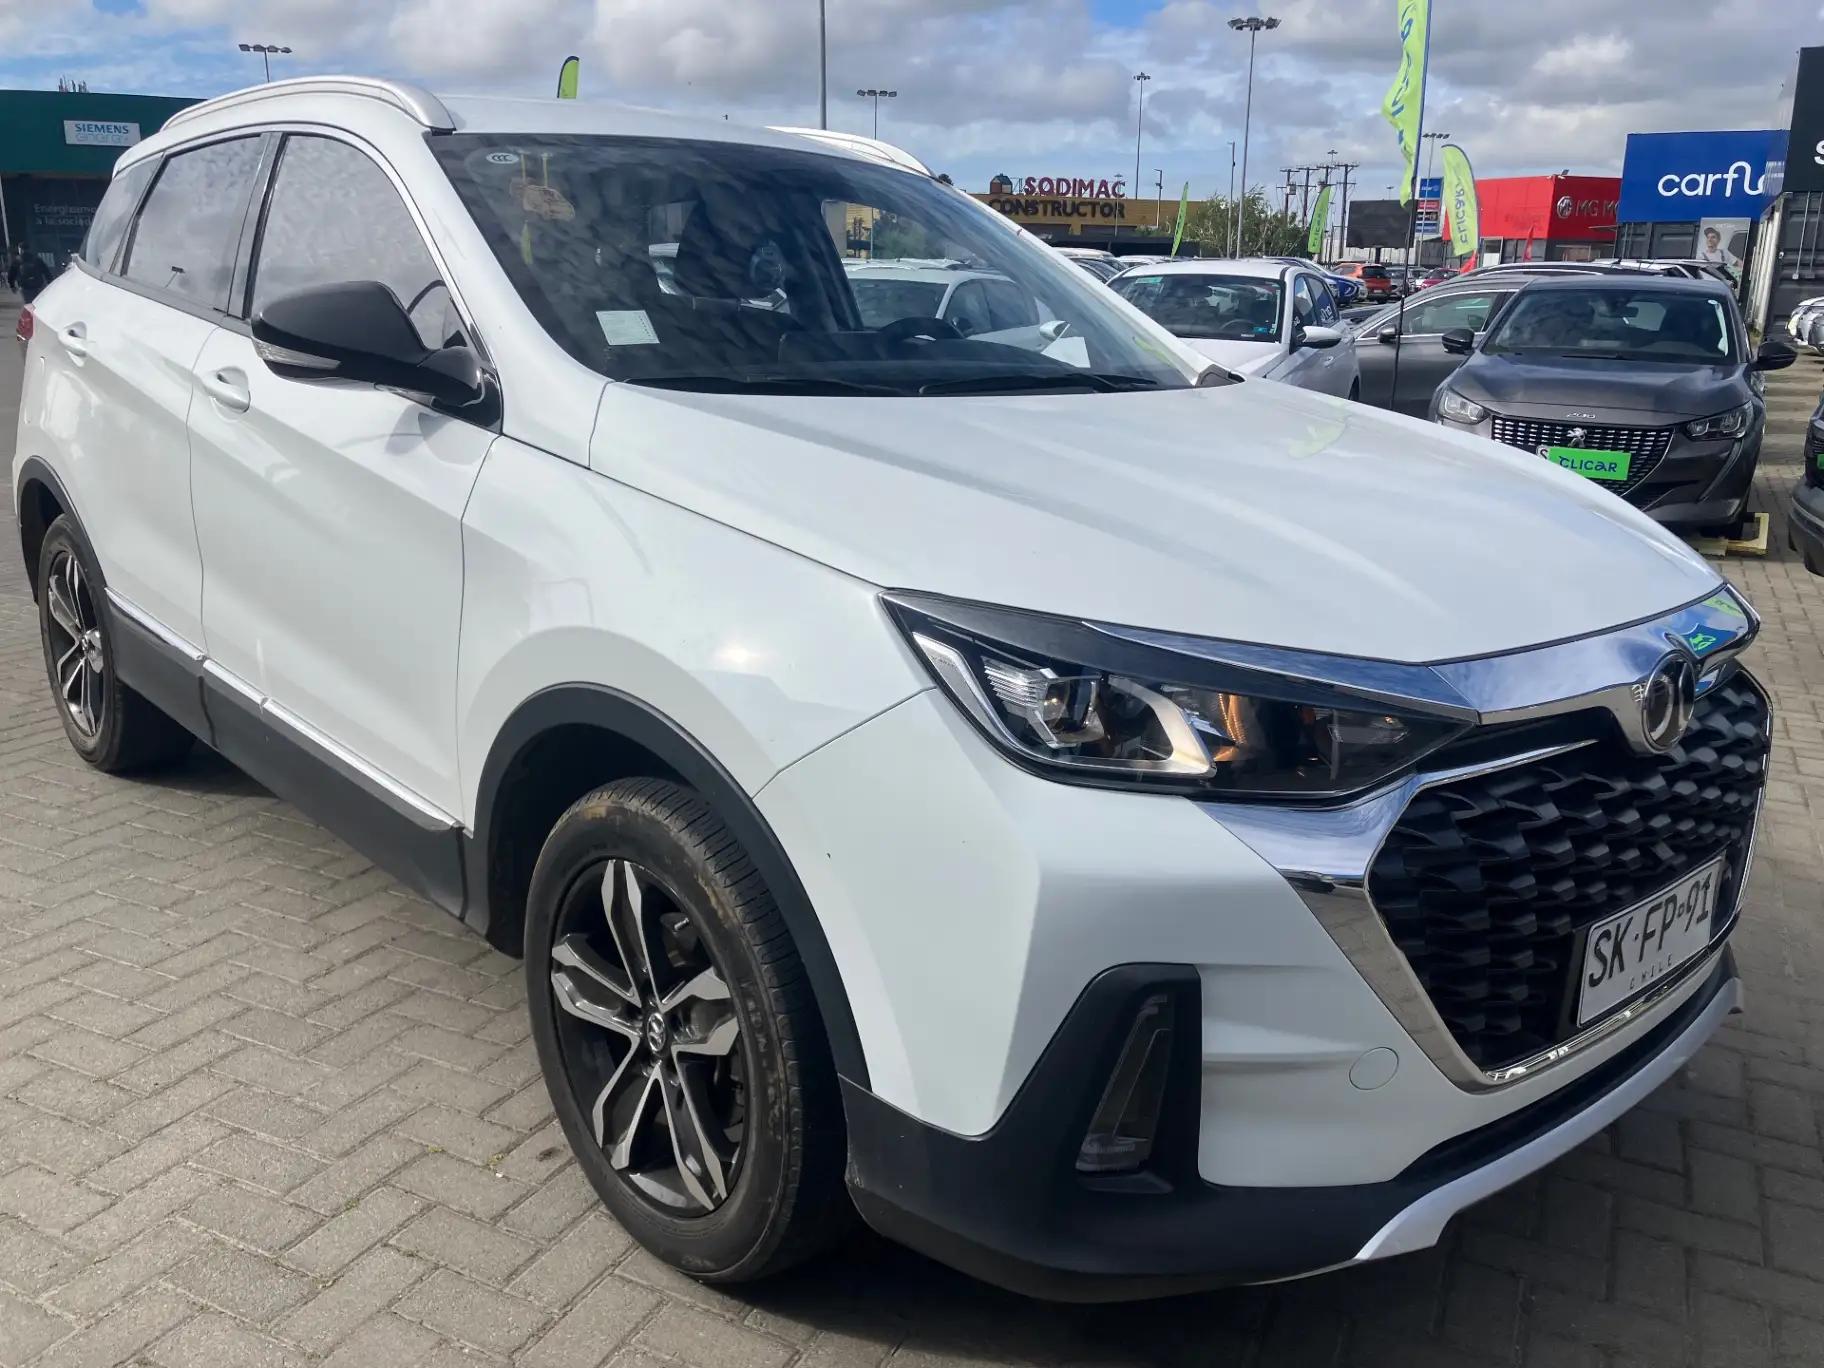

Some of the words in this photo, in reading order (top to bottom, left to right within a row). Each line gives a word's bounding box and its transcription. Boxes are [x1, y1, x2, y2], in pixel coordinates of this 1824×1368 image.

[75, 123, 129, 134] SIEMENS
[1024, 176, 1126, 199] SODIMAC
[988, 198, 1125, 218] CONSTRUCTOR
[1576, 200, 1598, 216] MG
[1629, 954, 1673, 990] CHILE
